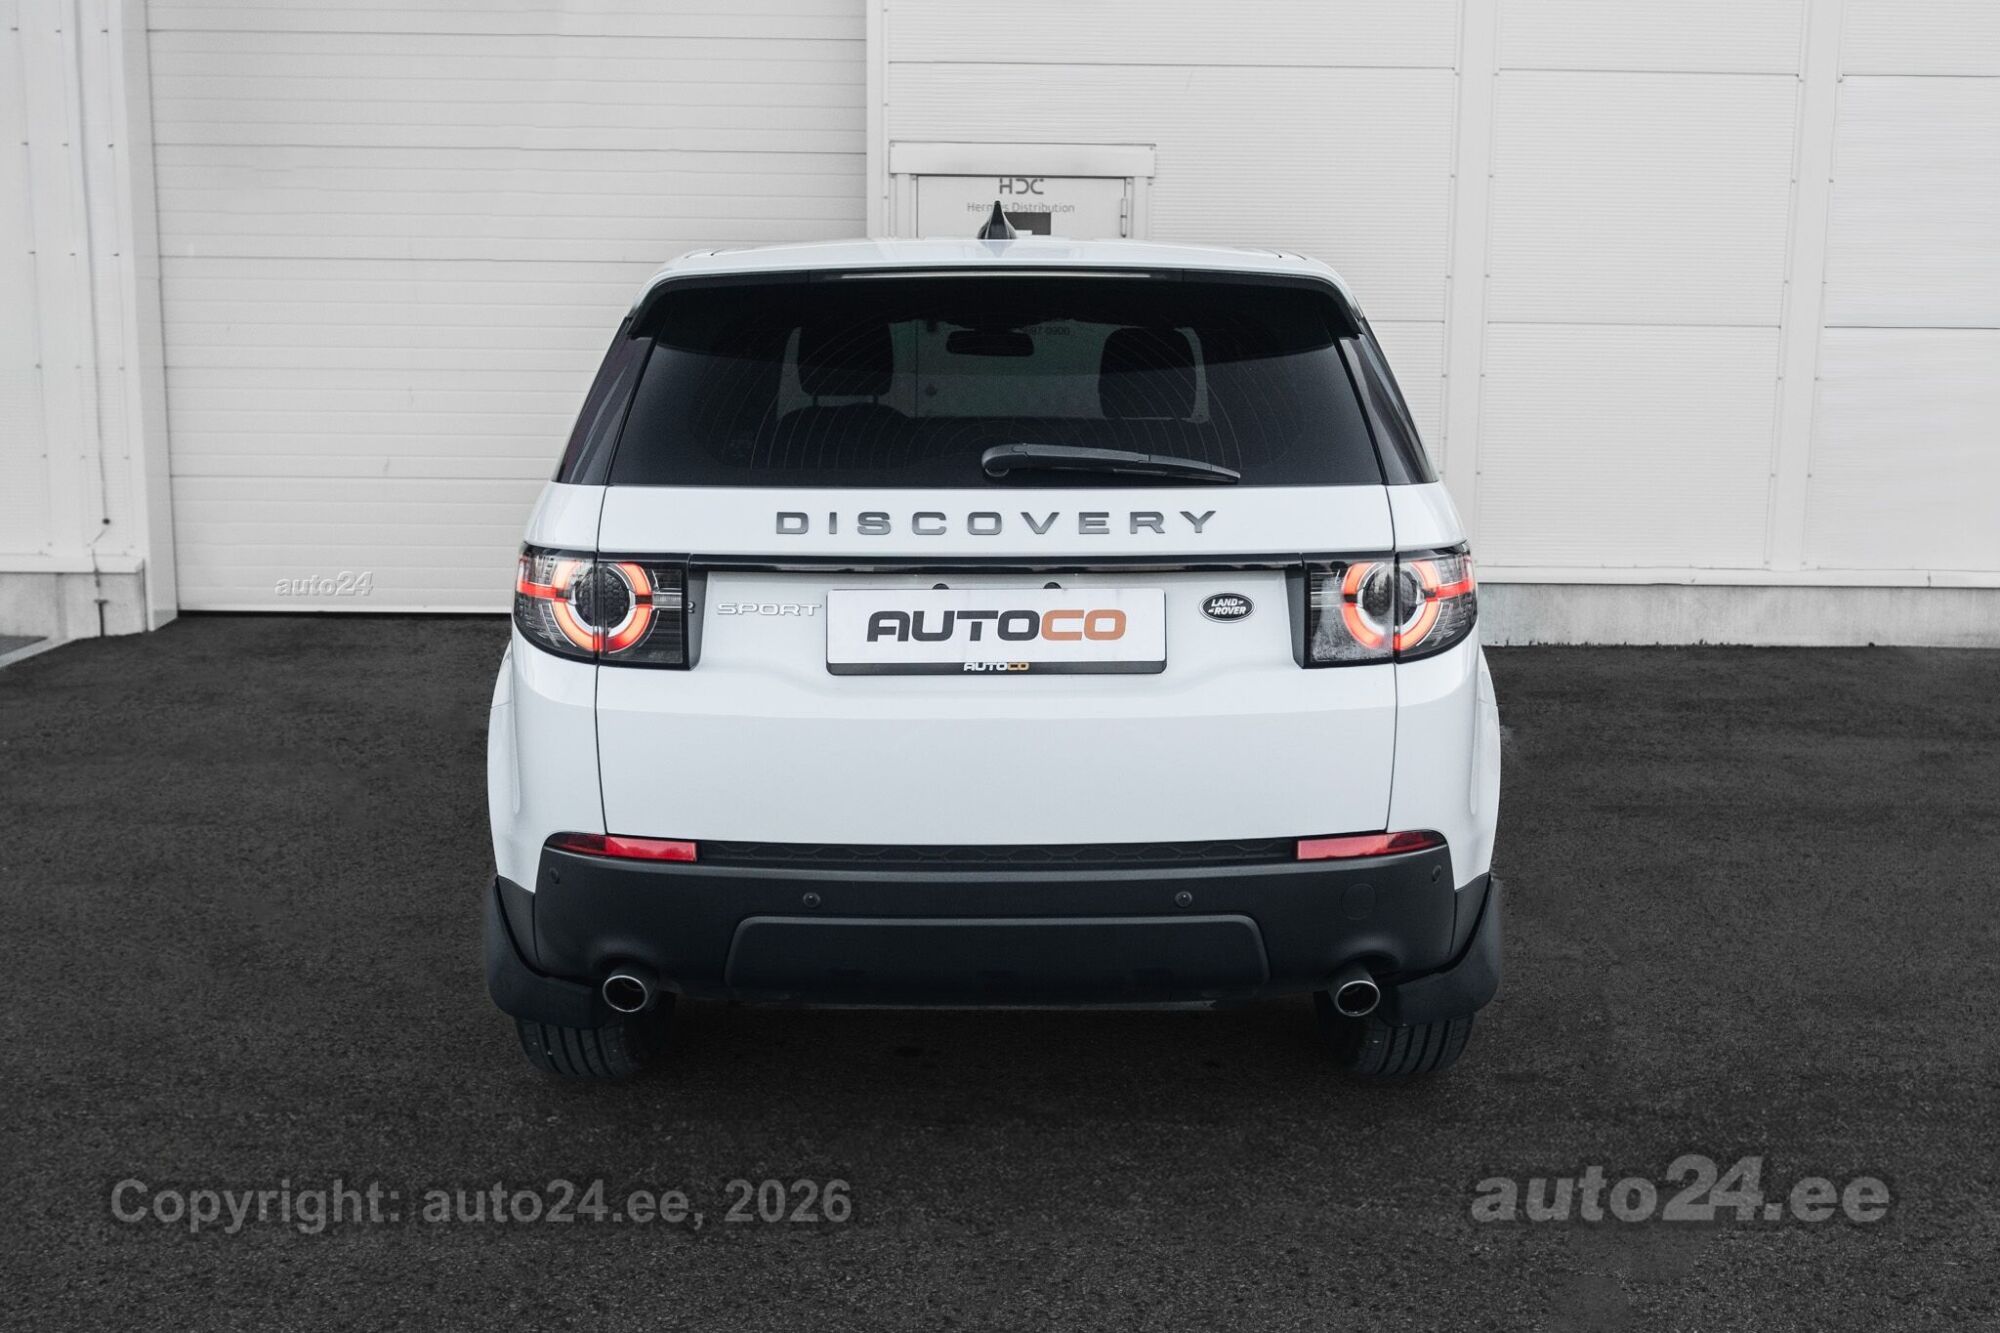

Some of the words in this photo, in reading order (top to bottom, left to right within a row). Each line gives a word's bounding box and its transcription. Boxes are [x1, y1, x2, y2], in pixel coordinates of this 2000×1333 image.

[1012, 202, 1075, 213] Distribution
[775, 511, 1216, 535] DISCOVERY
[718, 602, 822, 616] SPORT
[866, 609, 1126, 642] AUTOCO
[963, 662, 1029, 671] AUTOCO
